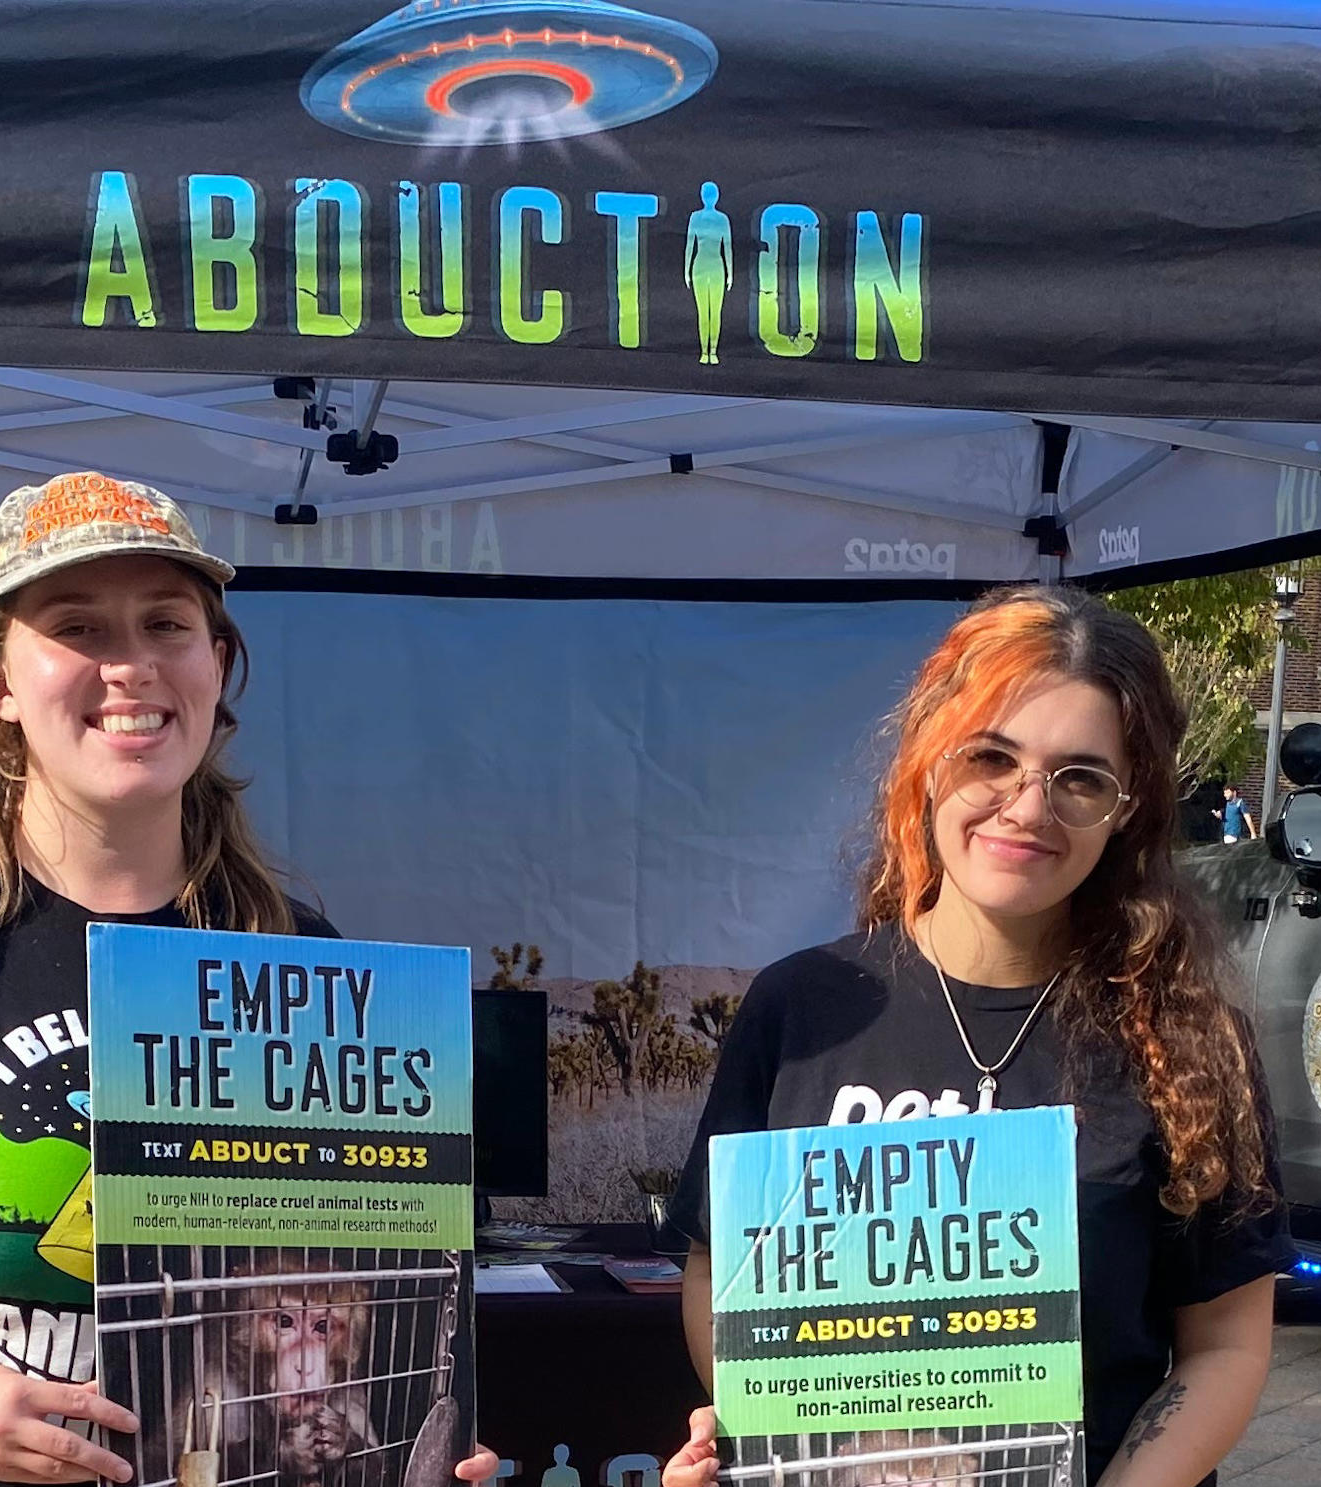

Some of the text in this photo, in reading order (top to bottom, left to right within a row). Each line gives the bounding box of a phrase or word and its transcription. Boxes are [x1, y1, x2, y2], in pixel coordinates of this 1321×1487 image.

[81, 171, 926, 364] ABDUCTION
[198, 959, 372, 1038] EMPTY
[2, 1009, 90, 1068] BEL
[133, 1034, 432, 1117] THE CAGES
[142, 1140, 428, 1168] TEXT ABDUCT TO 30933
[803, 1137, 975, 1218] EMPTY
[133, 1214, 437, 1234] modern, human-relevant, non-animal research methods!
[147, 1193, 425, 1211] to urge NIH to replace cruel animal tests with
[744, 1207, 1040, 1294] THE CAGES
[752, 1307, 1036, 1343] TEXT ABDUCT TO 30933
[745, 1364, 1046, 1395] to urge universities to commit to
[796, 1391, 994, 1417] non-animal research.
